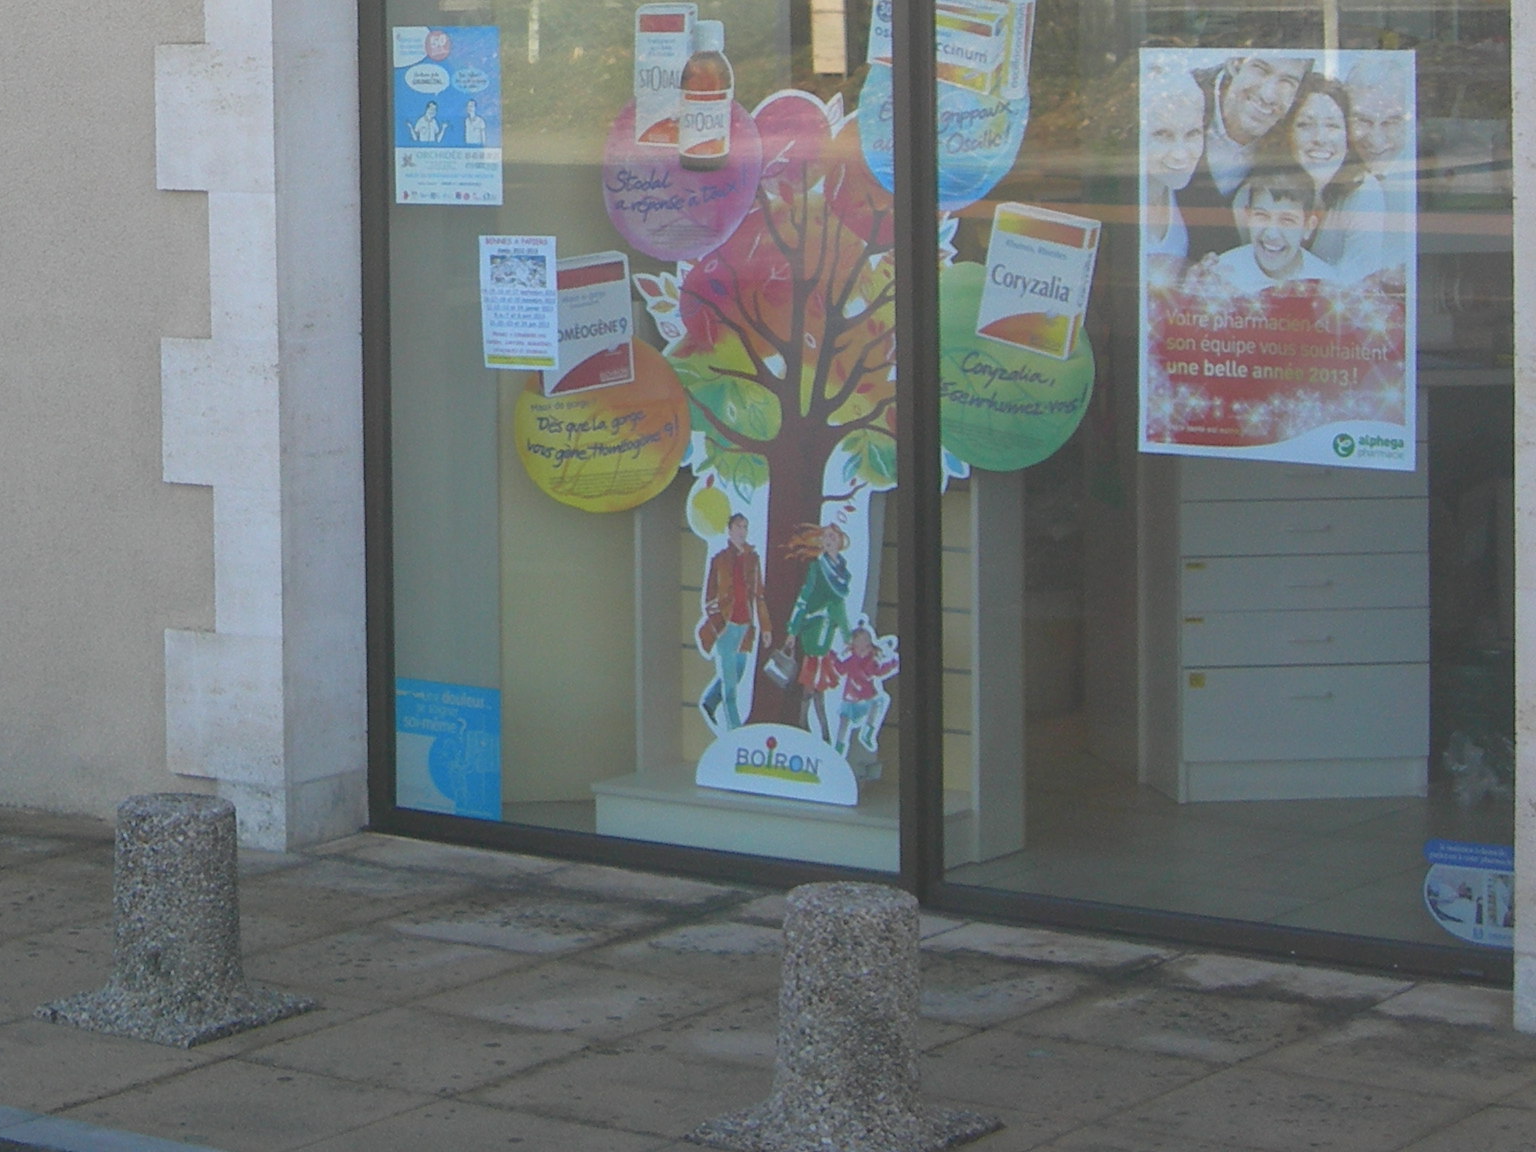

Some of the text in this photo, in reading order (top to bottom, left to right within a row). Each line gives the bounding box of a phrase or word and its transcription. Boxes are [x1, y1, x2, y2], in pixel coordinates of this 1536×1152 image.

[606, 168, 673, 193] Stodal
[992, 263, 1071, 302] Coryzalia
[619, 317, 628, 334] 9
[1167, 309, 1209, 327] Votre
[1214, 313, 1312, 332] pharmacien
[1167, 333, 1387, 361] son équipe vous souhaitent
[1167, 360, 1199, 376] une
[1203, 359, 1248, 378] belle
[1252, 363, 1304, 381] année
[537, 415, 564, 434] Dès
[565, 421, 590, 439] que
[610, 410, 647, 435] gorge
[1357, 433, 1405, 450] alphega
[736, 736, 819, 774] BOIRON
